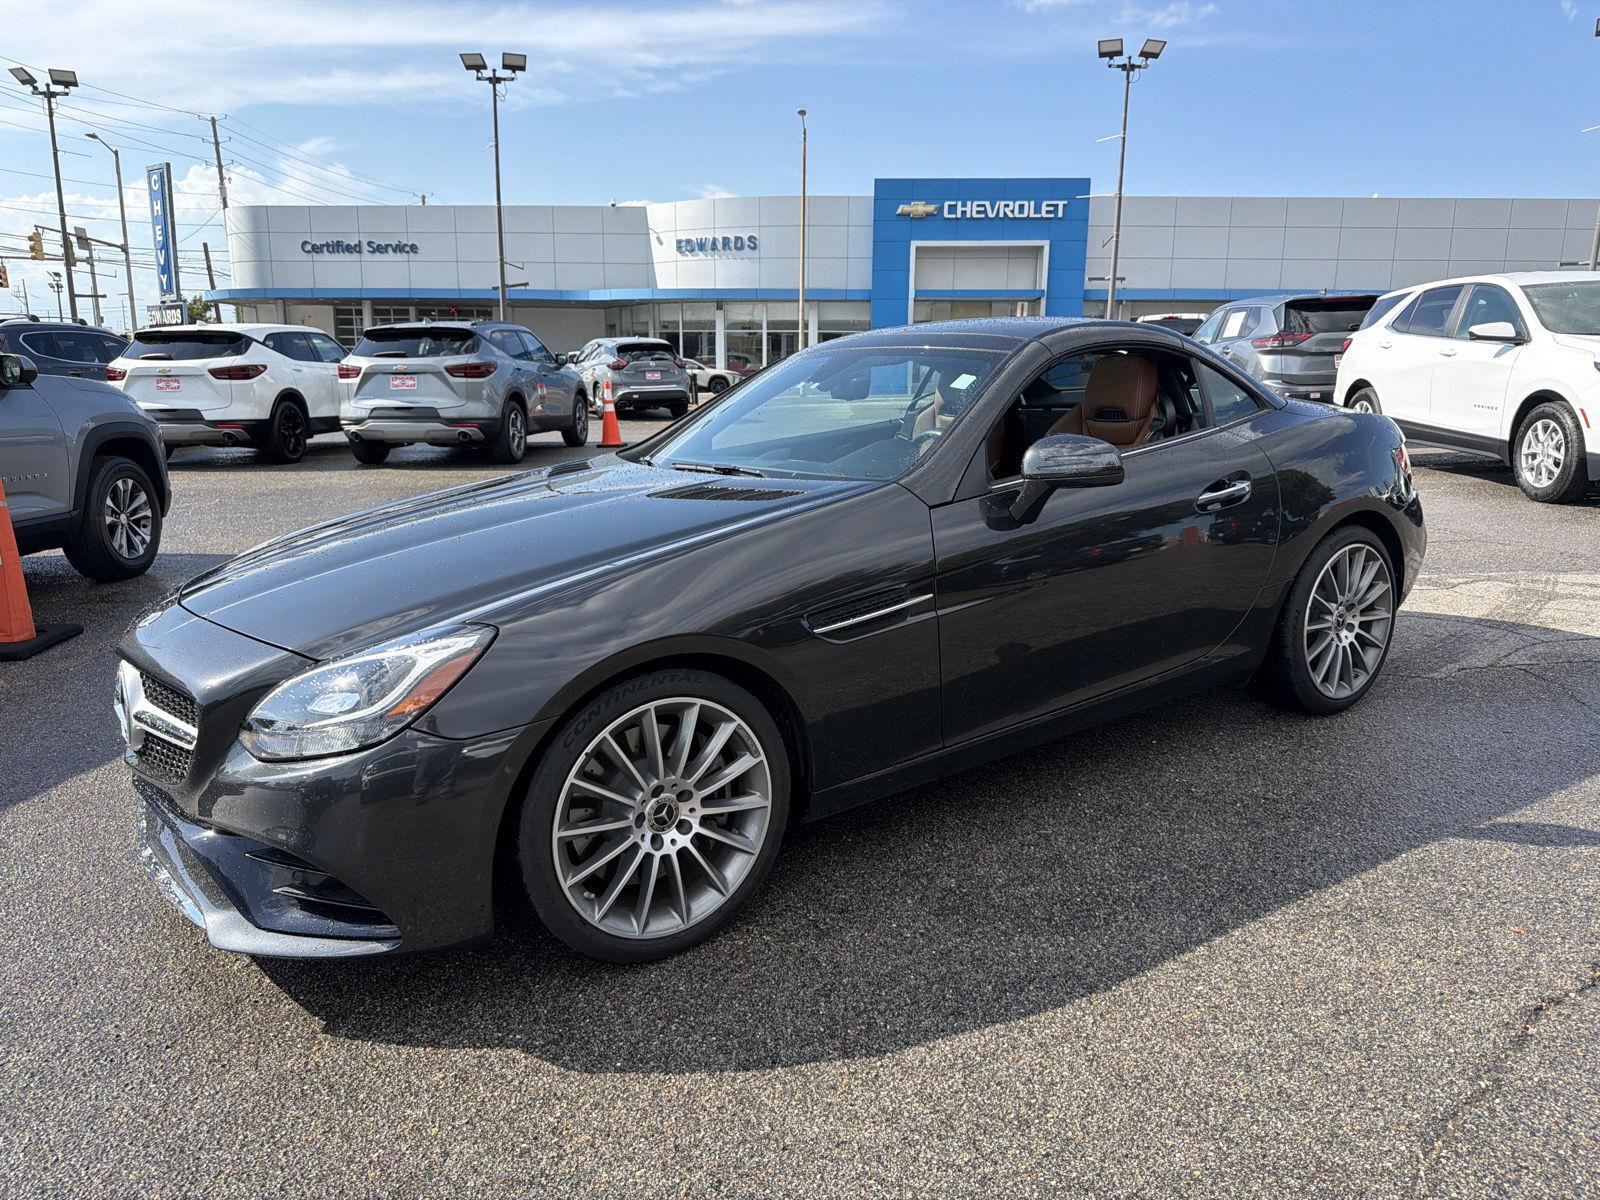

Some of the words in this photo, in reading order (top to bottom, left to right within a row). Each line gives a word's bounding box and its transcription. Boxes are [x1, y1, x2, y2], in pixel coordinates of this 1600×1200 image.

[943, 200, 1068, 218] CHEVROLET
[151, 174, 168, 290] CHEVY
[301, 240, 363, 254] Certified
[366, 240, 419, 254] Service
[675, 235, 759, 254] EDWARDS
[148, 308, 182, 325] EDWARDS
[1, 472, 48, 483] QUINOX
[563, 672, 704, 749] CONTINENTAL
